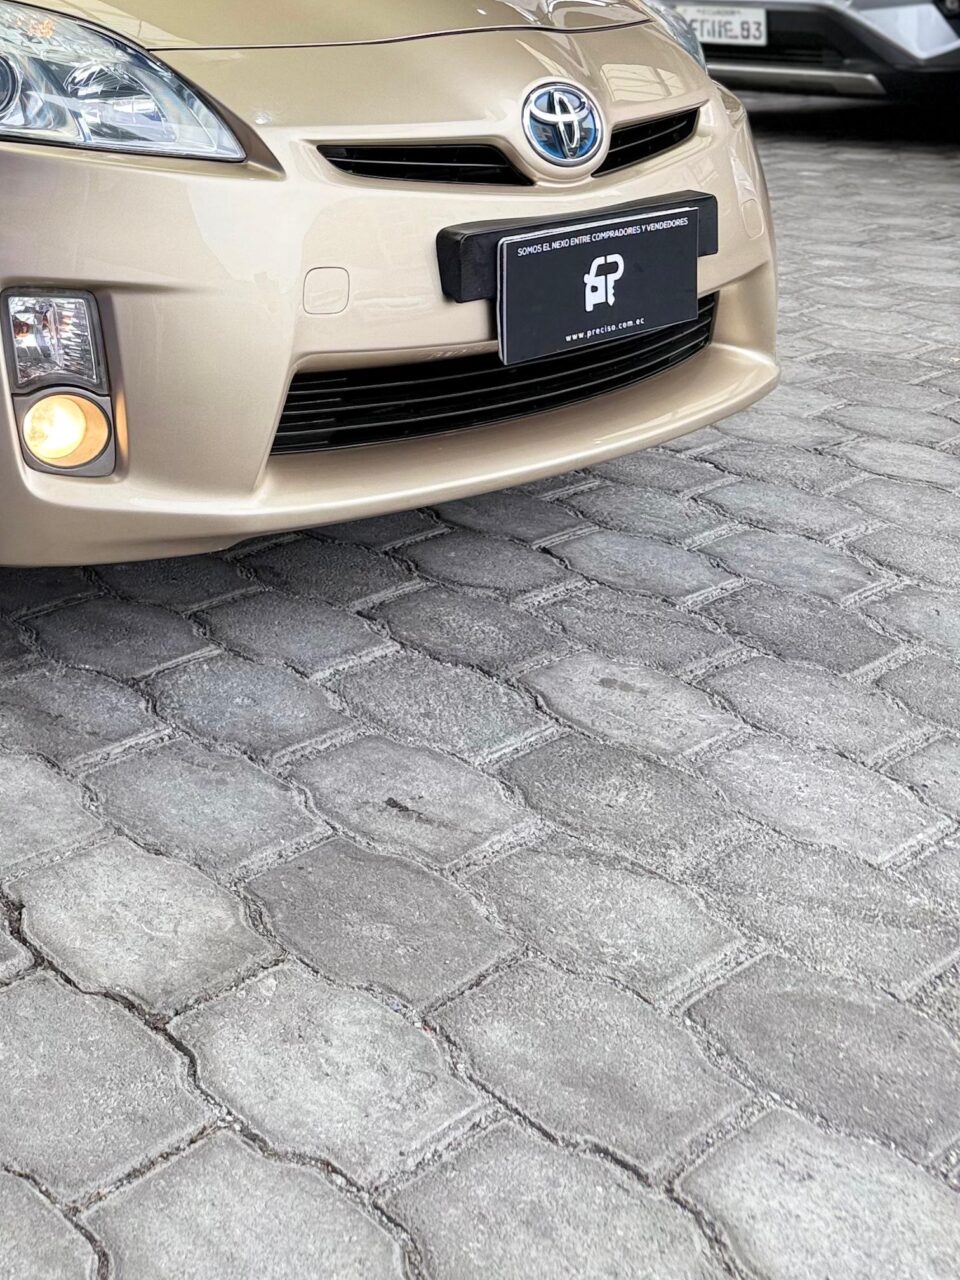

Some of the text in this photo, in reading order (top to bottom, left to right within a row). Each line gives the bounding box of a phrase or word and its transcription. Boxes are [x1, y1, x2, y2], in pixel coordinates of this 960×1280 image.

[517, 244, 543, 256] SOMOS
[543, 243, 551, 251] EL
[552, 238, 570, 250] NEXO
[570, 235, 591, 246] ENTRE
[591, 225, 641, 242] COMPRADORES
[646, 217, 689, 232] VENDEDORES
[565, 317, 645, 342] www.preciso.com.ec
